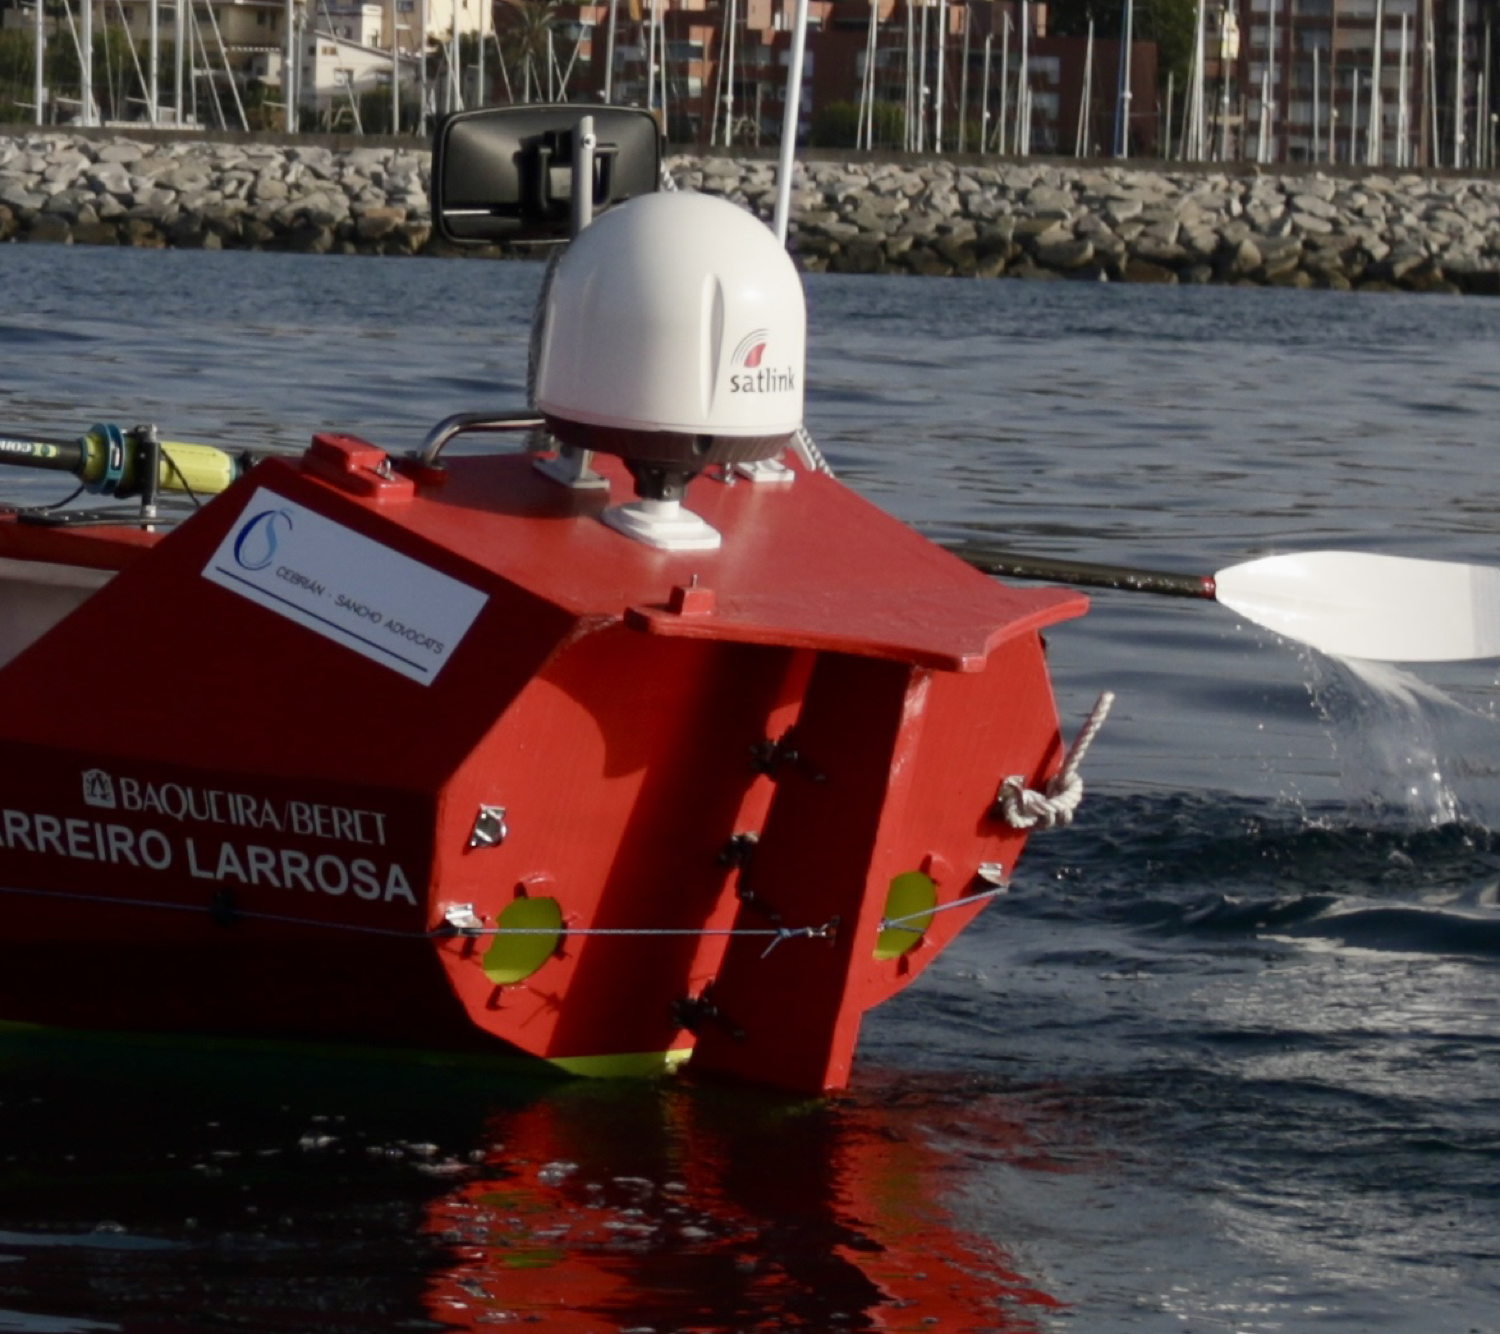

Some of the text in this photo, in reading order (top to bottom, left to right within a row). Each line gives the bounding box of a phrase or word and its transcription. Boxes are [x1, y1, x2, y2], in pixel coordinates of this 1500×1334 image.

[730, 365, 795, 393] satlink
[333, 594, 382, 624] SANCHO
[384, 620, 445, 655] ADVOCATS
[187, 838, 417, 906] LARROSA
